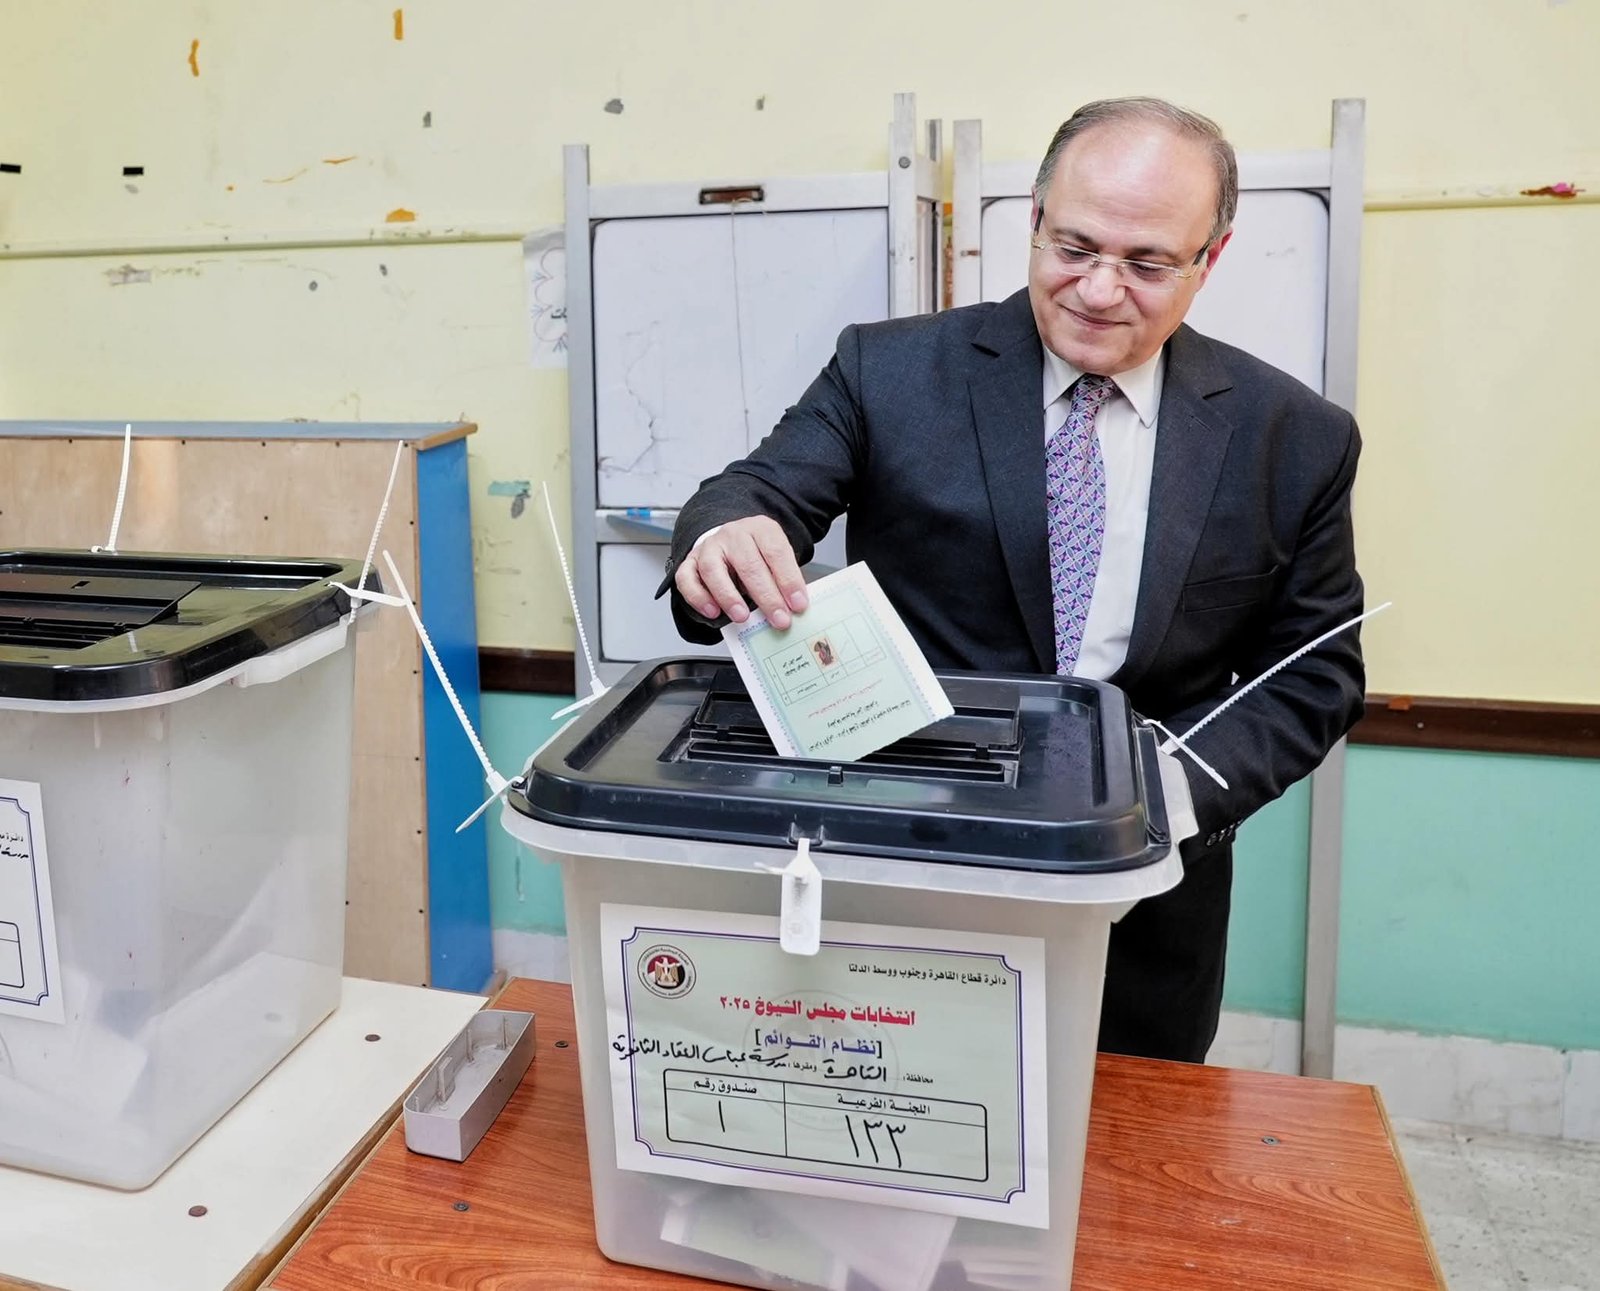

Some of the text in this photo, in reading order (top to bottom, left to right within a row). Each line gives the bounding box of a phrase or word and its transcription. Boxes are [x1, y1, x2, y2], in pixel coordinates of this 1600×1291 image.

[848, 963, 1007, 986] دائرة قطاع القاهرة وجنوب ووسط الدلتا
[720, 996, 915, 1028] انتخابات مجلس الشيوخ ٢٠٢٥
[662, 1041, 700, 1059] العقاد
[693, 1079, 757, 1095] صندوق رقم
[837, 1093, 931, 1115] اللجنة الفرعية
